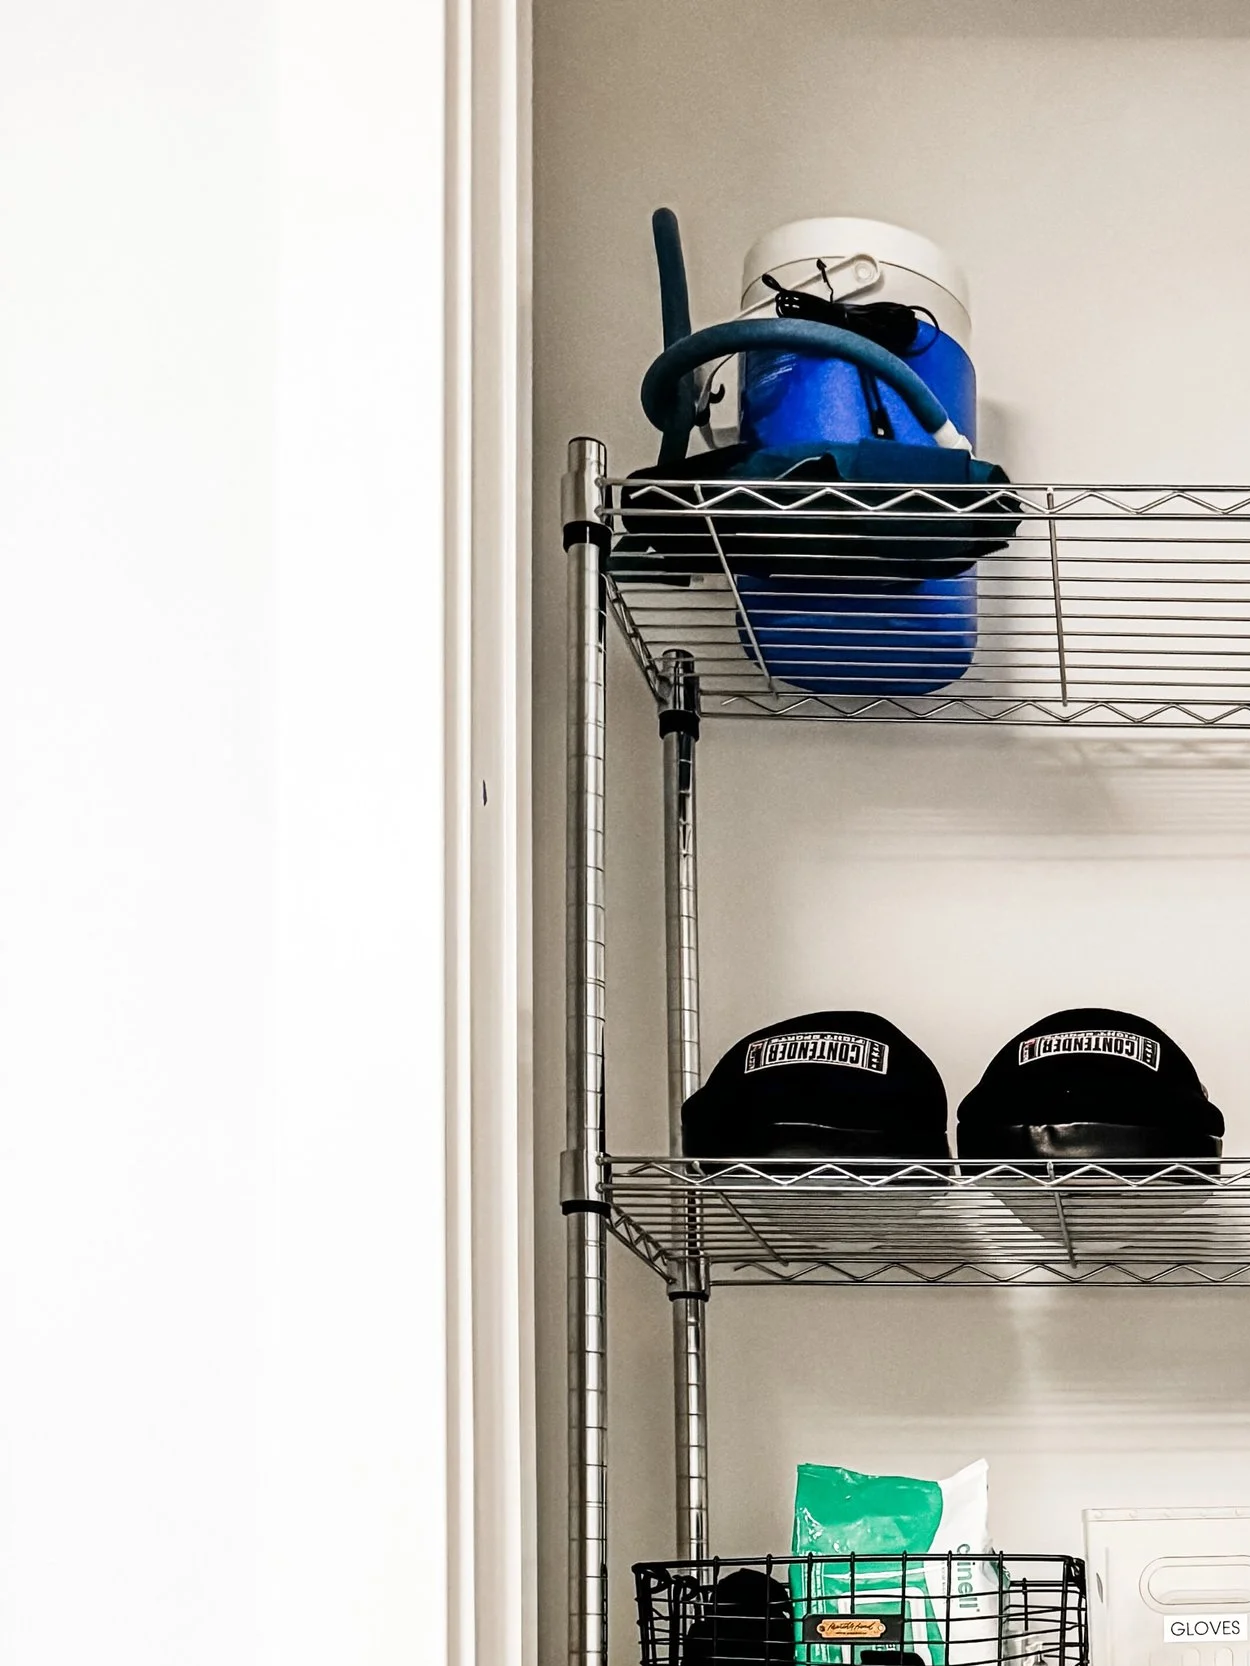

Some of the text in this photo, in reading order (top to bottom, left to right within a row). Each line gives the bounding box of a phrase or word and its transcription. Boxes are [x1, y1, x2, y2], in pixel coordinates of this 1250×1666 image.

[767, 1041, 862, 1064] CONTENDER
[1042, 1037, 1136, 1057] CONTENDER
[1170, 1621, 1240, 1637] GLOVES
